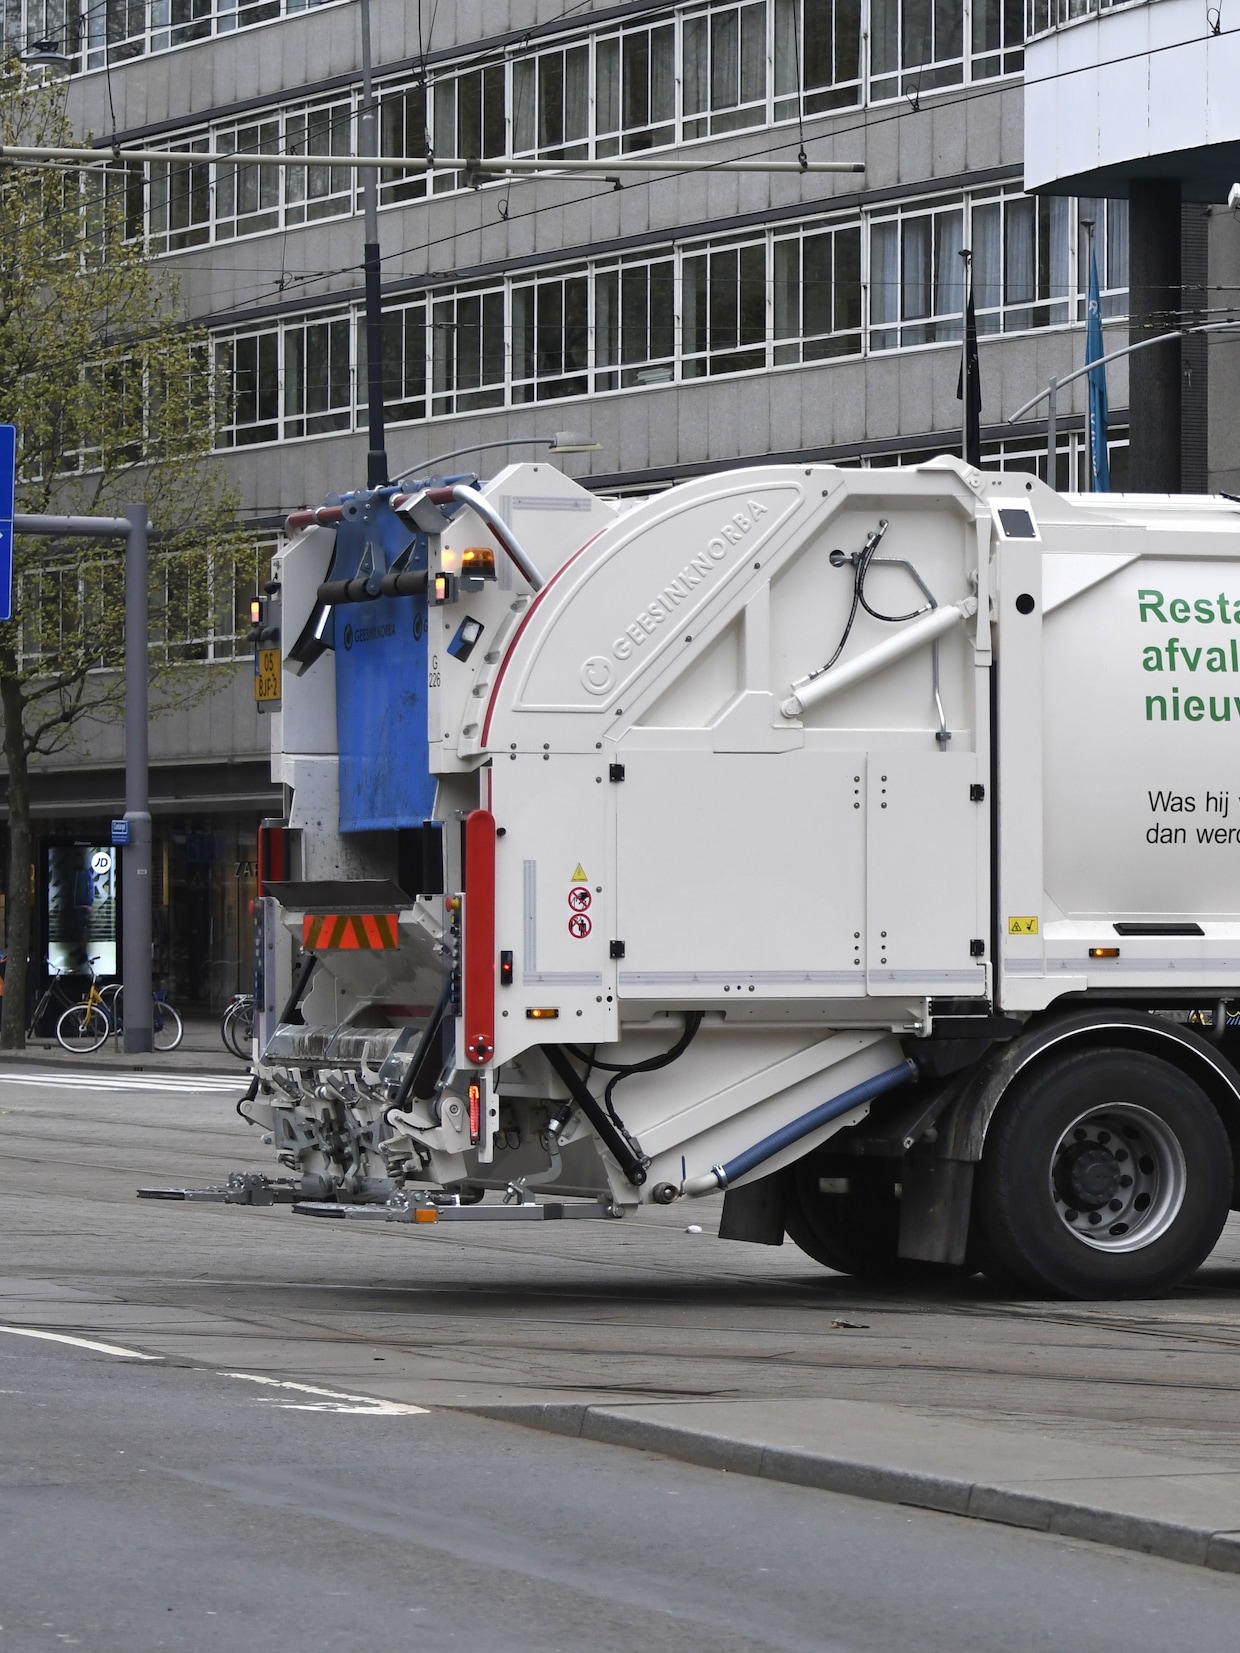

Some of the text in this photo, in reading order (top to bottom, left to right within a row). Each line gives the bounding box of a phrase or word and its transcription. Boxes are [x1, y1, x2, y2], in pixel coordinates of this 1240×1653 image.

[612, 499, 768, 660] GEESINKNORBA
[432, 654, 438, 670] G
[1142, 637, 1239, 673] afval
[428, 672, 441, 688] 226
[1148, 790, 1196, 813] Was
[1205, 790, 1229, 818] hij
[1146, 822, 1187, 844] dan
[94, 857, 108, 868] JD
